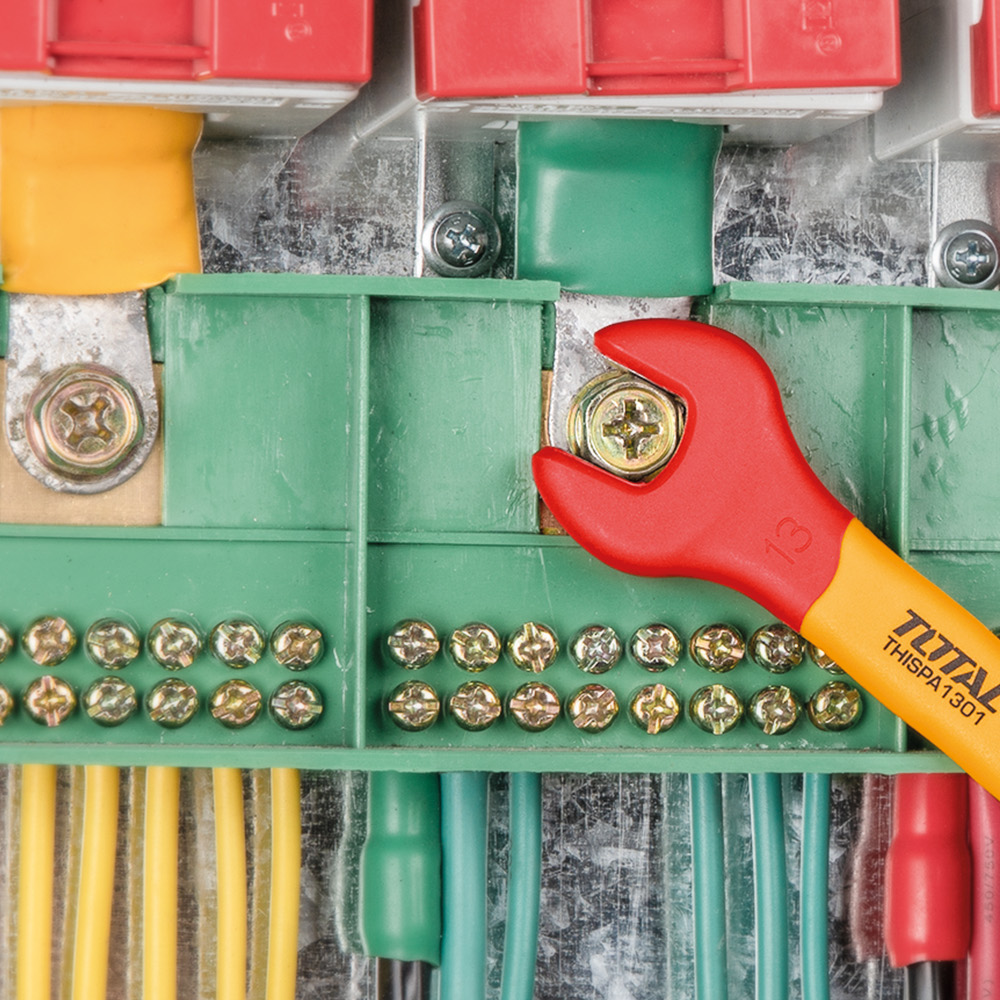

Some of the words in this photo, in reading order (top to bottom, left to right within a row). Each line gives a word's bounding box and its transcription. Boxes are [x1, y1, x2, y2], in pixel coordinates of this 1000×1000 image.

[764, 516, 813, 565] 13
[883, 635, 986, 725] THISPA1301
[984, 836, 995, 923] 450/750V
